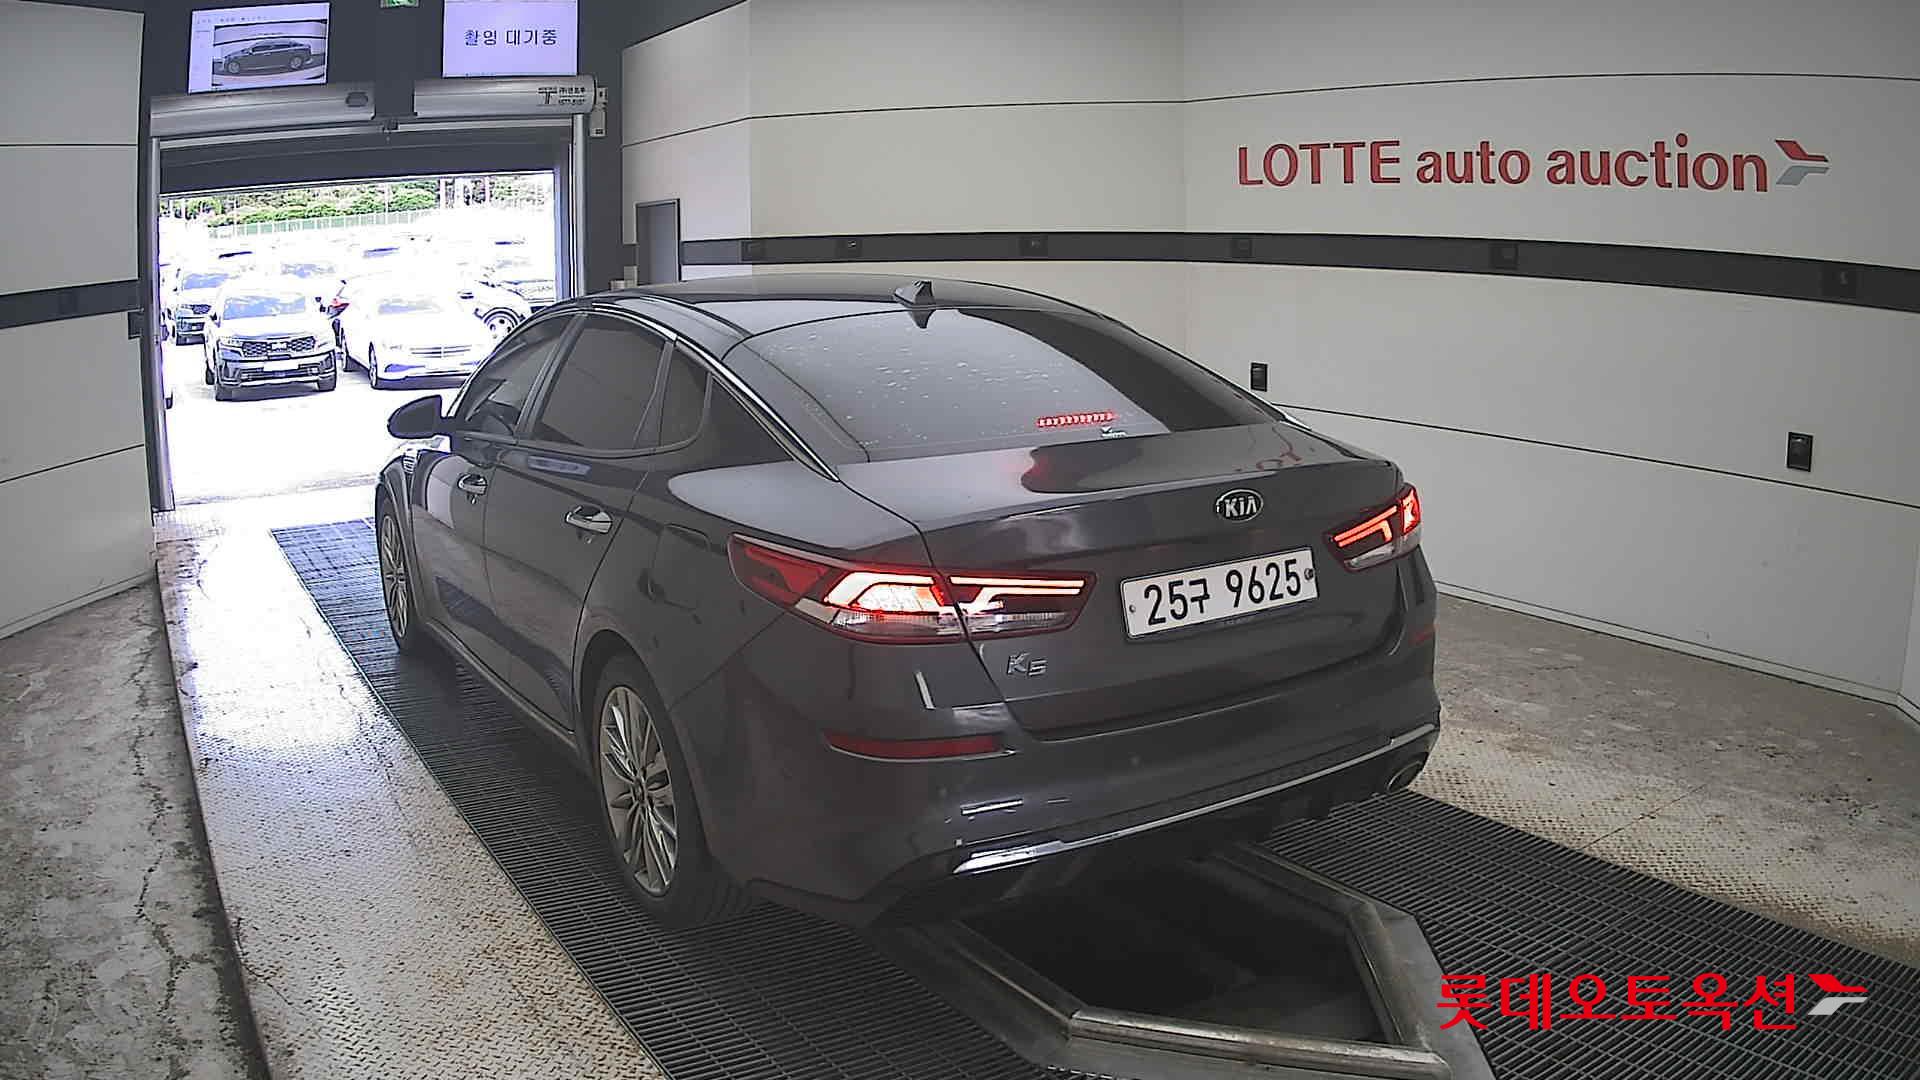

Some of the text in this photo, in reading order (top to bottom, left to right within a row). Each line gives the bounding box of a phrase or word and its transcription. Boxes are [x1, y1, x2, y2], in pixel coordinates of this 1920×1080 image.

[506, 29, 557, 46] 대기중
[1238, 133, 1768, 192] LOTTE auto auction
[1225, 496, 1257, 517] KIA
[1144, 559, 1302, 625] 25구 9625
[1006, 652, 1047, 676] K5
